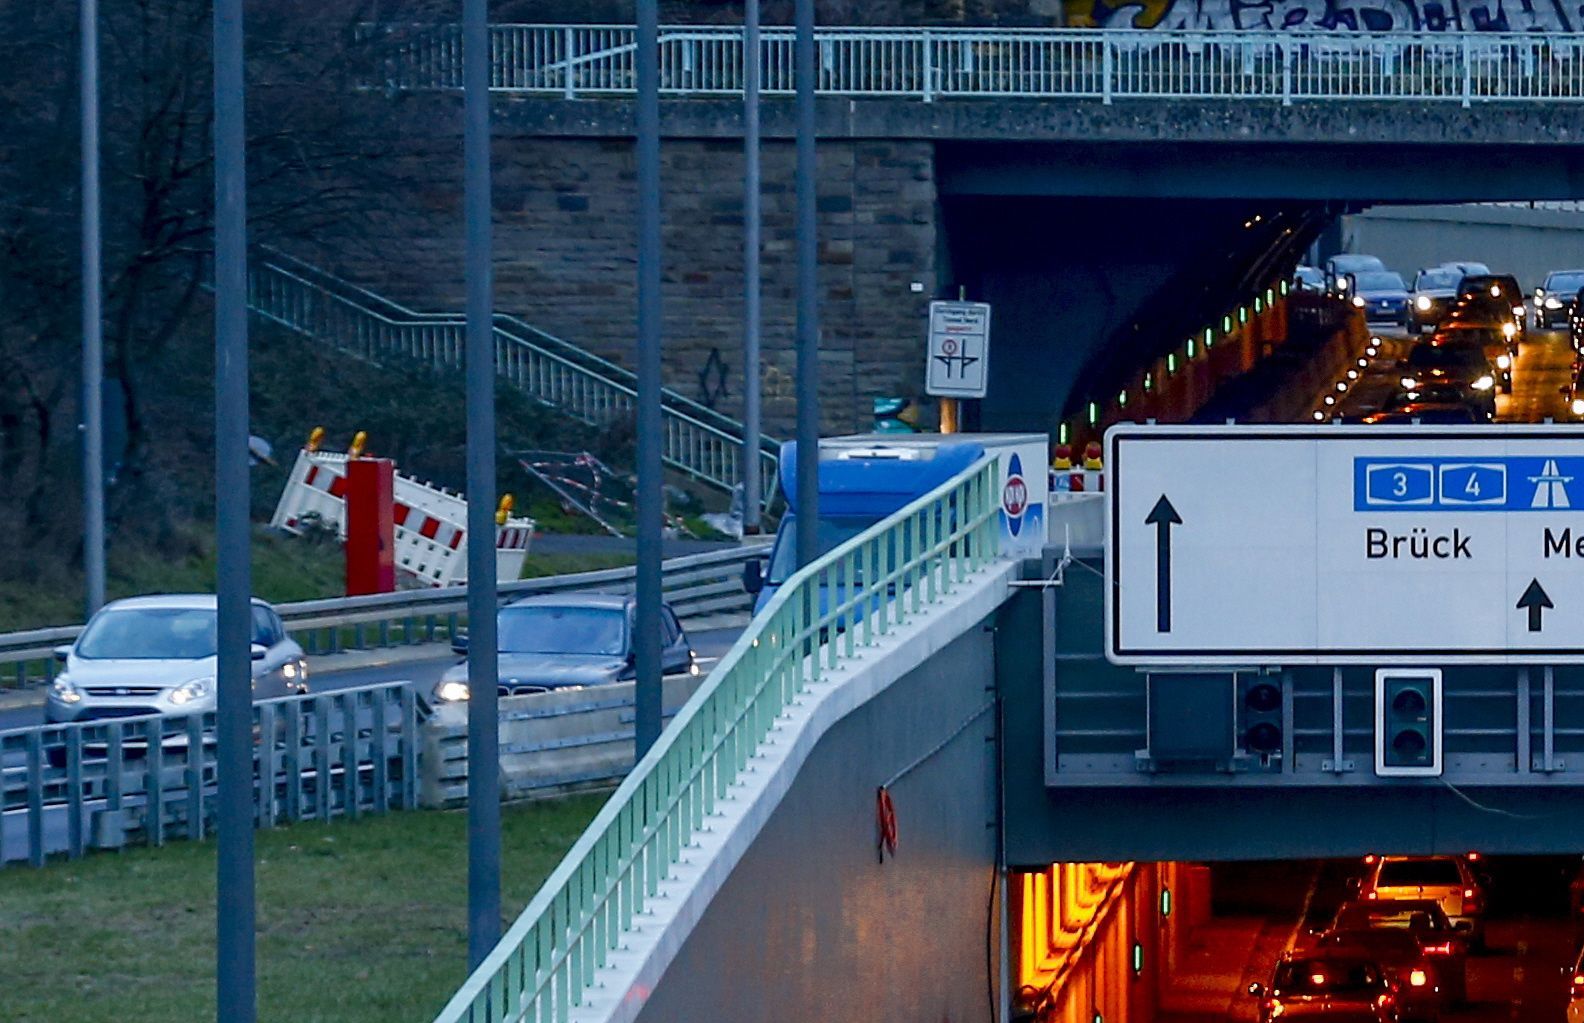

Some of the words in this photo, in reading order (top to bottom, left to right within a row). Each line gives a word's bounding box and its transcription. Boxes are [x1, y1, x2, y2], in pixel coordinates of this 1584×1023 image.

[1393, 472, 1407, 496] 3
[1465, 472, 1480, 496] 4
[1365, 527, 1473, 559] Brück
